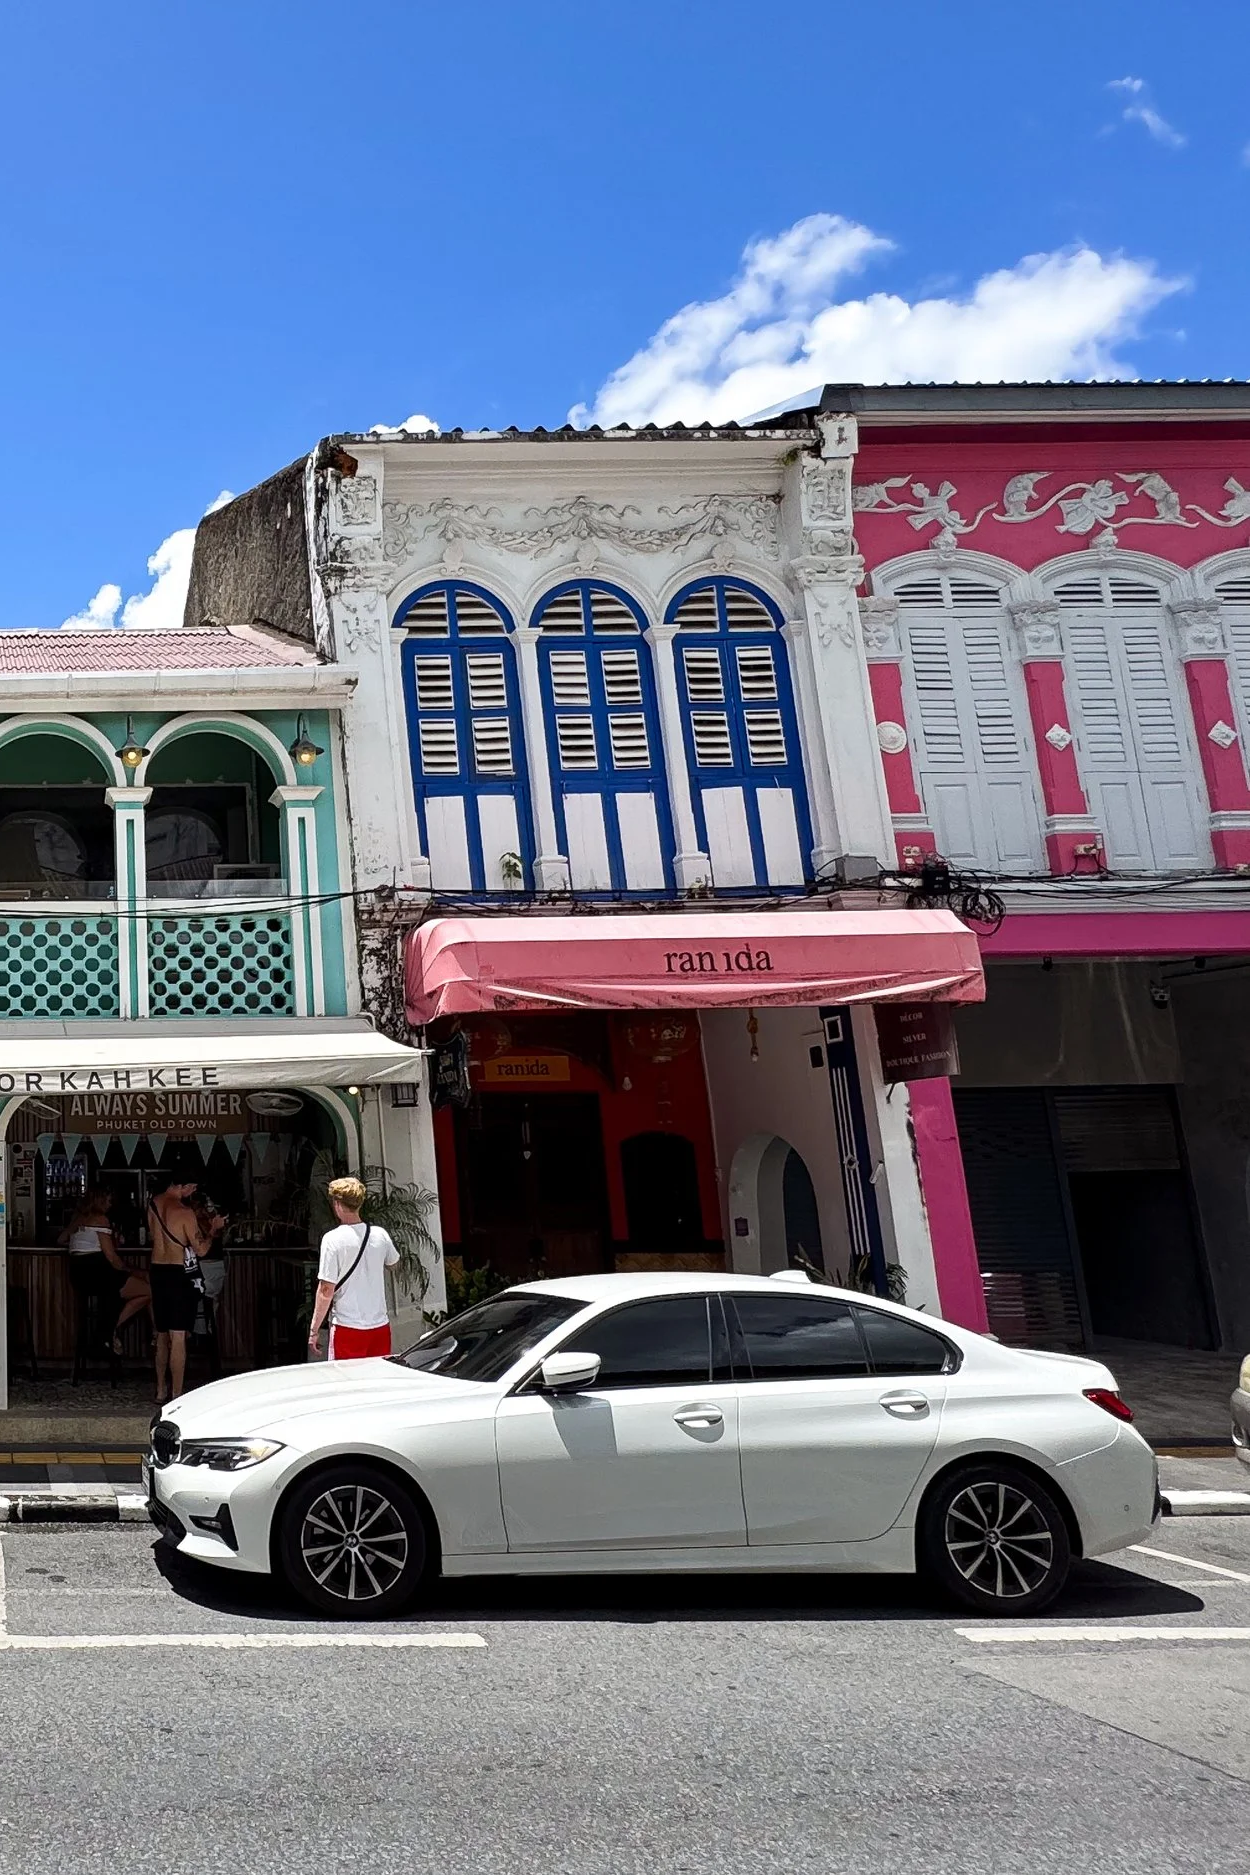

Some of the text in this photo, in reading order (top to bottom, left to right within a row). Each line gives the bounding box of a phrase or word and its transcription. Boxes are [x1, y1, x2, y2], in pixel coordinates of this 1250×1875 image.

[902, 1033, 926, 1044] SILVER
[497, 1058, 550, 1077] ranida
[886, 1055, 920, 1067] BOUTIQUE
[59, 1070, 132, 1091] KAH
[148, 1067, 220, 1088] KEE
[70, 1092, 242, 1116] ALWAYS SUMMER
[97, 1119, 217, 1130] PHUKET OLD TOWN
